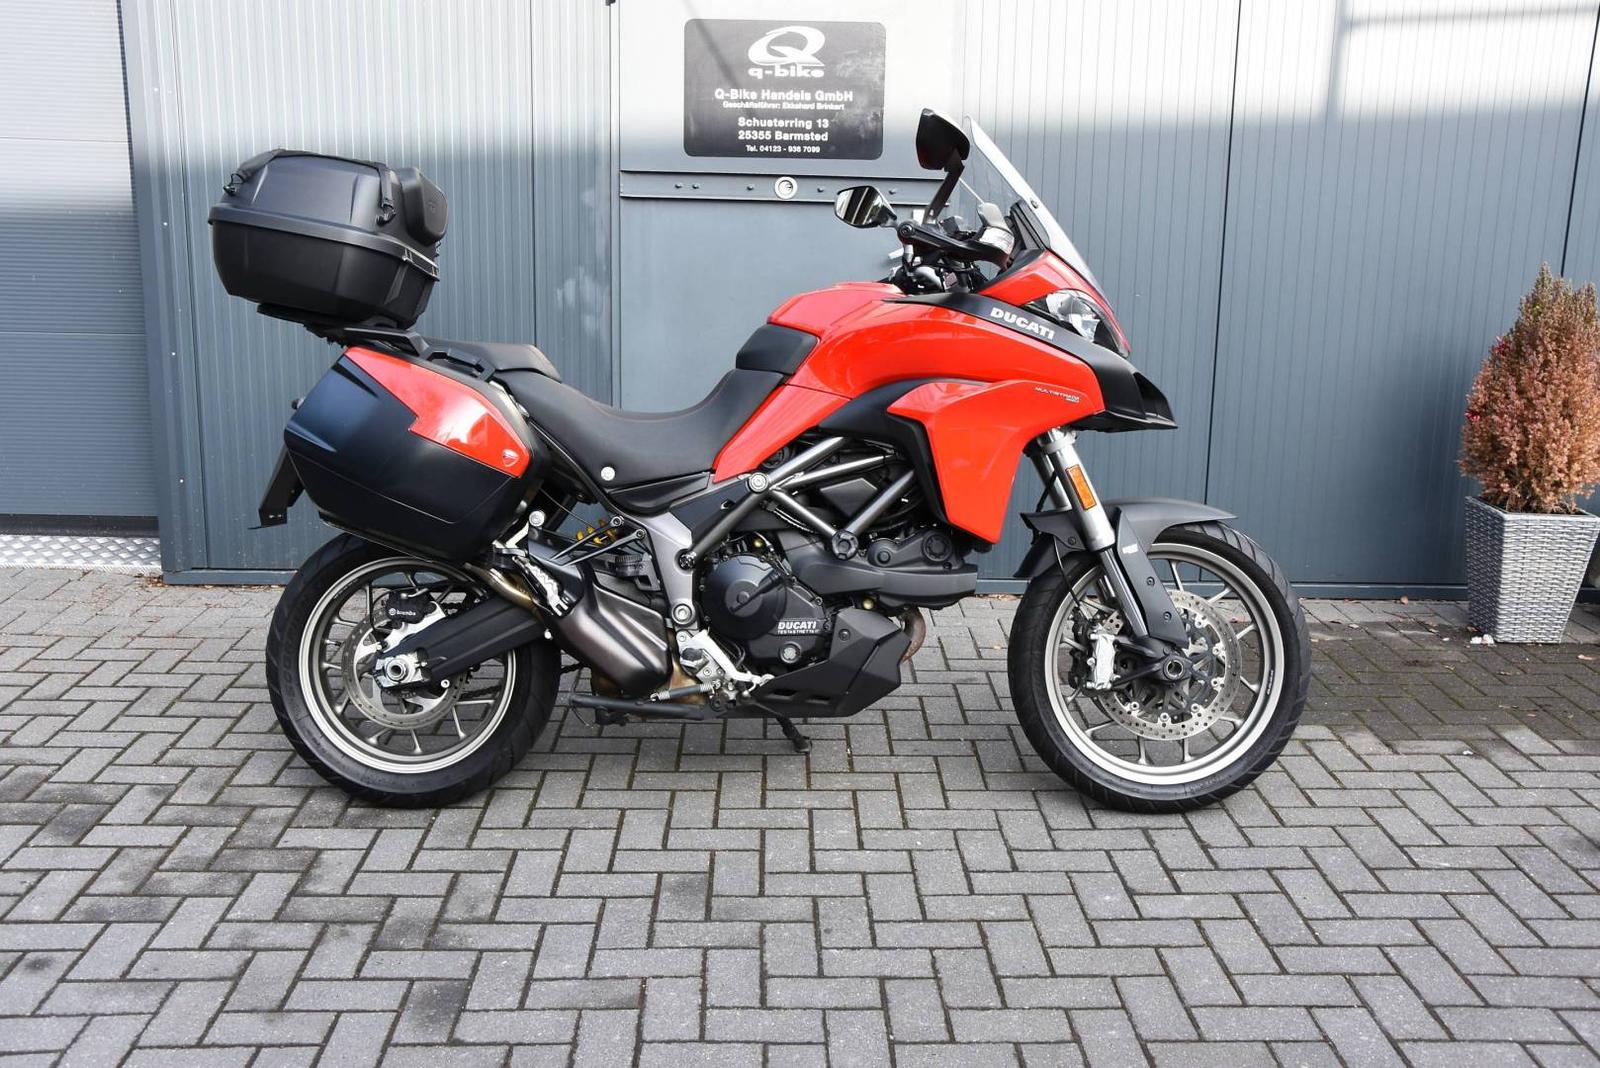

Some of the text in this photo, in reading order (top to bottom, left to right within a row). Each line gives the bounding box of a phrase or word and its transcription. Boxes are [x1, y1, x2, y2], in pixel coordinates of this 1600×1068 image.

[747, 63, 825, 79] q-bike
[714, 88, 853, 102] Q-Bike Handels GmbH
[738, 116, 829, 130] Schusterring 13
[738, 130, 829, 142] 25355 Barmsted
[745, 144, 759, 152] Tel.
[760, 144, 782, 153] 04123
[990, 307, 1055, 340] DUCATI
[778, 621, 817, 630] DUCATI
